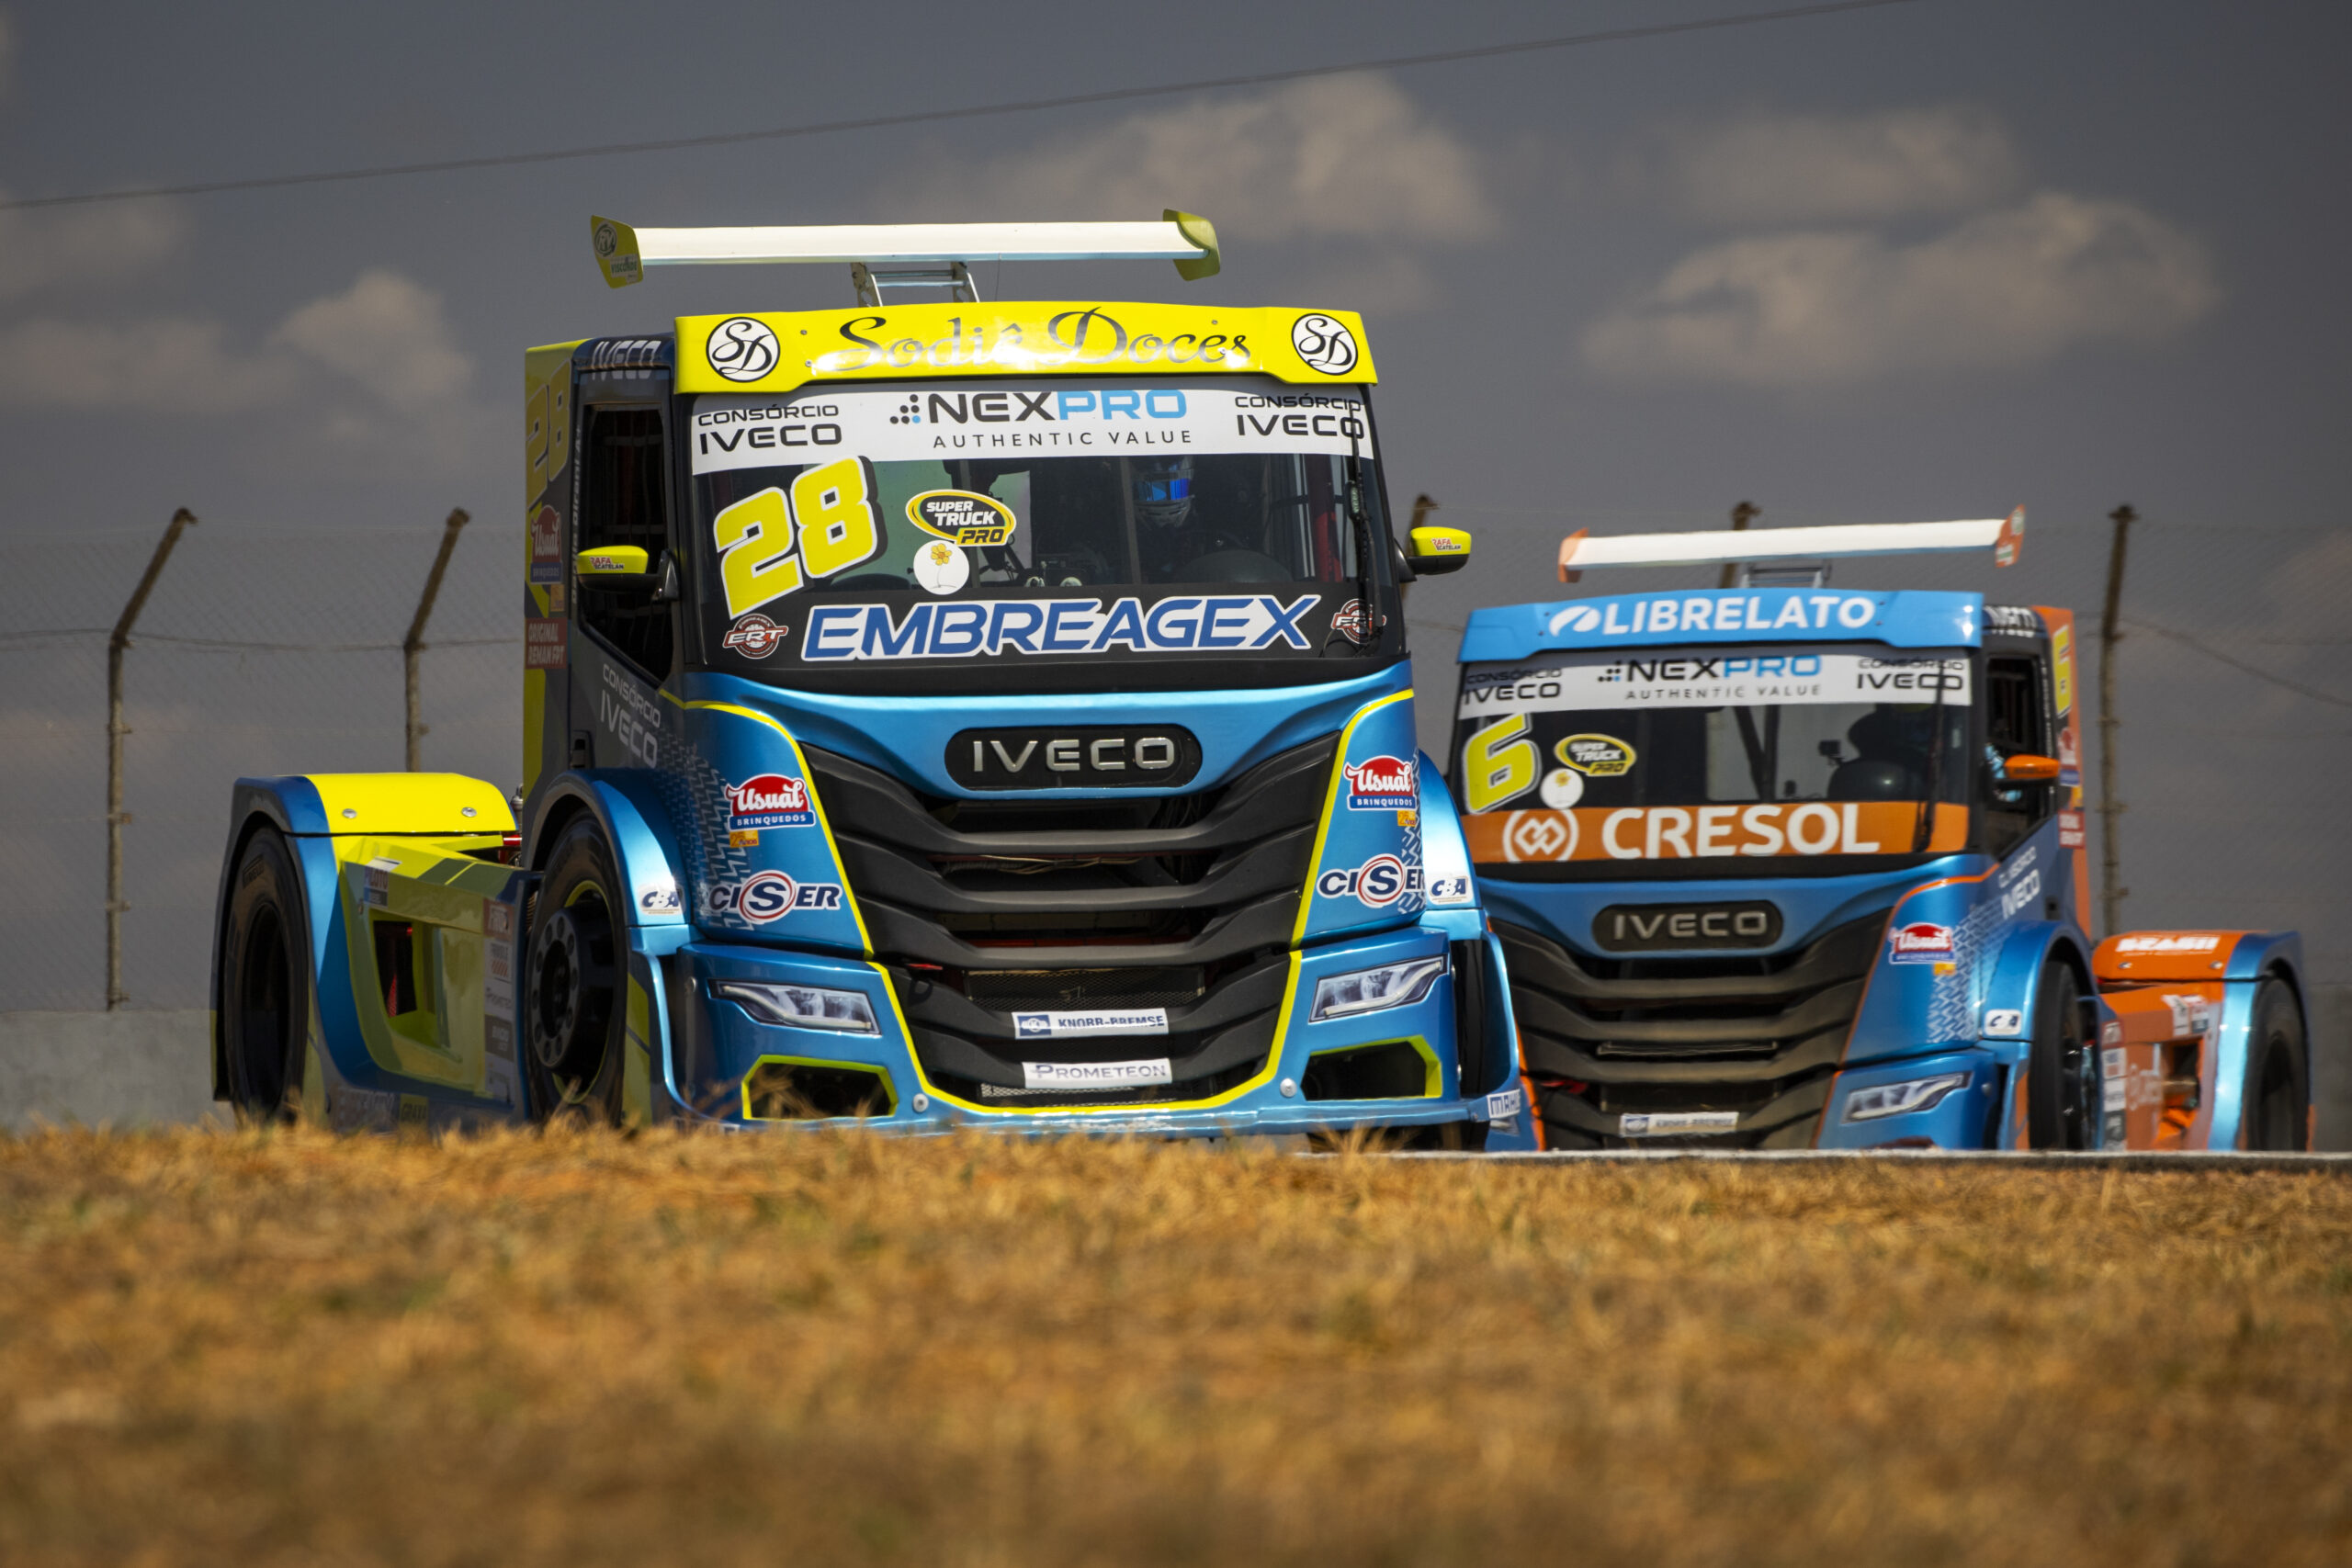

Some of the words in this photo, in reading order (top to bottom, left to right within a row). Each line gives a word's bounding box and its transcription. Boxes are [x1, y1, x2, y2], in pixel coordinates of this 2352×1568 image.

[1047, 306, 1252, 366] Doces
[698, 403, 840, 425] CONSÓRCIO
[928, 389, 1188, 424] NEXPRO
[1235, 393, 1362, 412] CONSÓRCIO
[1237, 414, 1365, 439] IVECO
[700, 423, 842, 455] IVECO
[933, 432, 1093, 449] AUTHENTIC
[1109, 430, 1192, 446] VALUE
[926, 501, 974, 513] SUPER
[934, 510, 997, 526] TRUCK
[713, 455, 878, 620] 28
[960, 528, 1005, 544] PRO
[1601, 595, 1876, 636] LIBRELATO
[727, 629, 785, 645] ERT
[805, 597, 1320, 659] EMBREAGEX
[1626, 654, 1823, 682] NEXPRO
[1624, 685, 1746, 701] AUTHENTIC
[1757, 684, 1822, 698] VALUE
[1857, 672, 1964, 691] IVECO
[1463, 682, 1561, 705] IVECO
[600, 689, 658, 770] IVECO
[973, 737, 1176, 773] IVECO
[1463, 712, 1543, 816] 6
[1576, 749, 1623, 762] TRUCK
[1347, 763, 1413, 792] Usual
[728, 781, 805, 812] Usual
[1356, 797, 1413, 807] BRINQUEDOS
[737, 814, 807, 826] BRINQUEDOS
[1601, 803, 1881, 859] CRESOL
[708, 881, 841, 912] CISER
[1430, 878, 1467, 897] CBA
[1613, 910, 1769, 941] IVECO
[1057, 1014, 1165, 1029] KNORR-BREMSE
[1989, 1014, 2020, 1028] CA
[1030, 1063, 1167, 1079] PROMETEON
